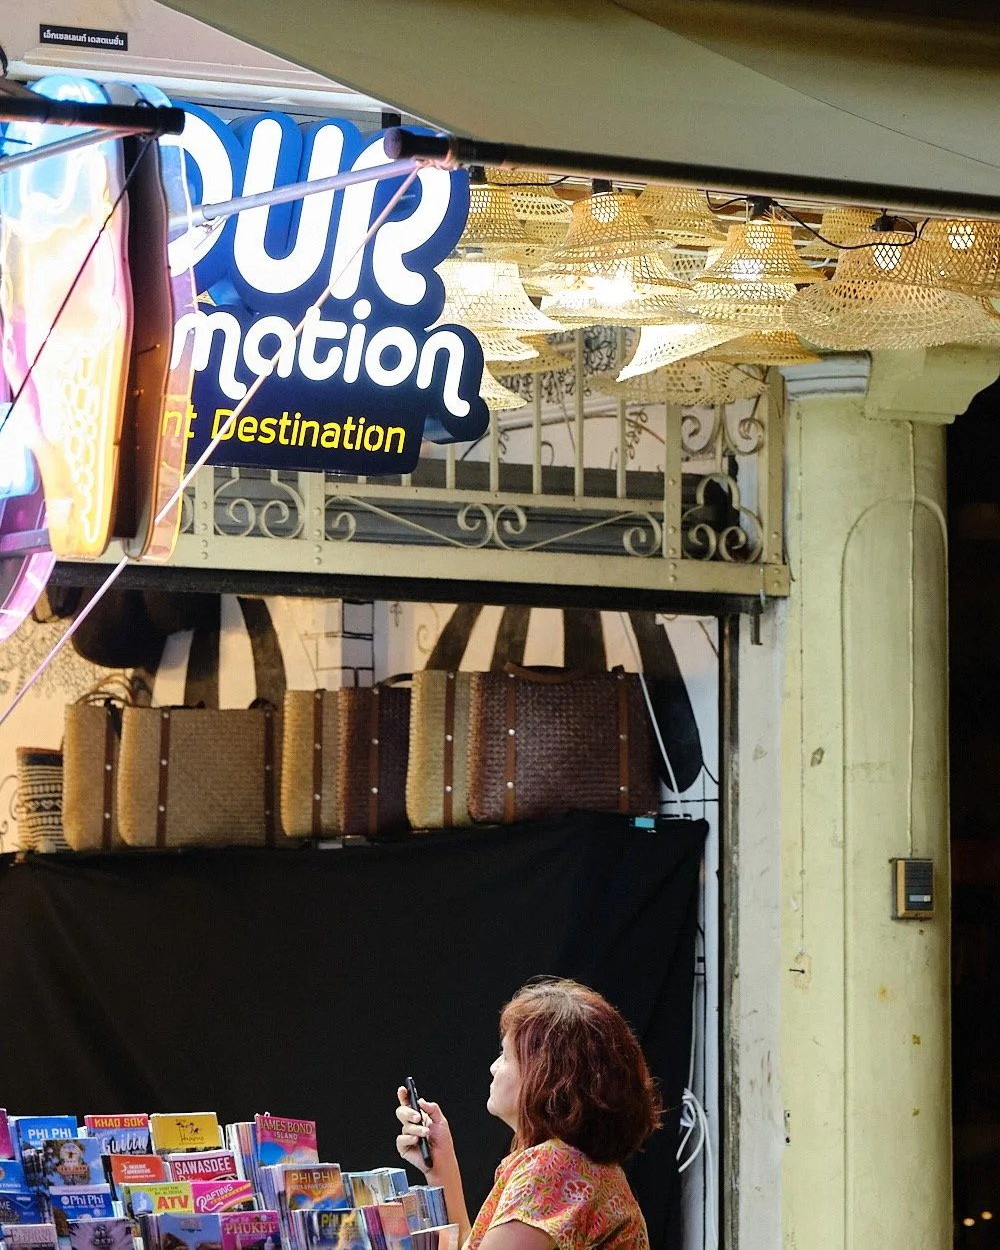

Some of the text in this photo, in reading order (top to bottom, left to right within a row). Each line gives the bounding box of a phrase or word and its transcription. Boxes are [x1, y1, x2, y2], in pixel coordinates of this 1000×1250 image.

[168, 110, 454, 307] OUR
[170, 300, 472, 418] mation
[211, 407, 407, 455] Destination
[94, 1116, 146, 1128] KHAO SOK
[258, 1119, 313, 1135] JAMES BOND
[28, 1128, 72, 1140] PHI PHI
[273, 1131, 298, 1141] ISLAND
[174, 1156, 232, 1176] SAWASDEE
[291, 1171, 334, 1183] PHI PHI
[69, 1194, 104, 1205] Phi Phi
[157, 1194, 189, 1211] ATV
[195, 1183, 234, 1212] RAFTING
[225, 1221, 274, 1235] PHUKET
